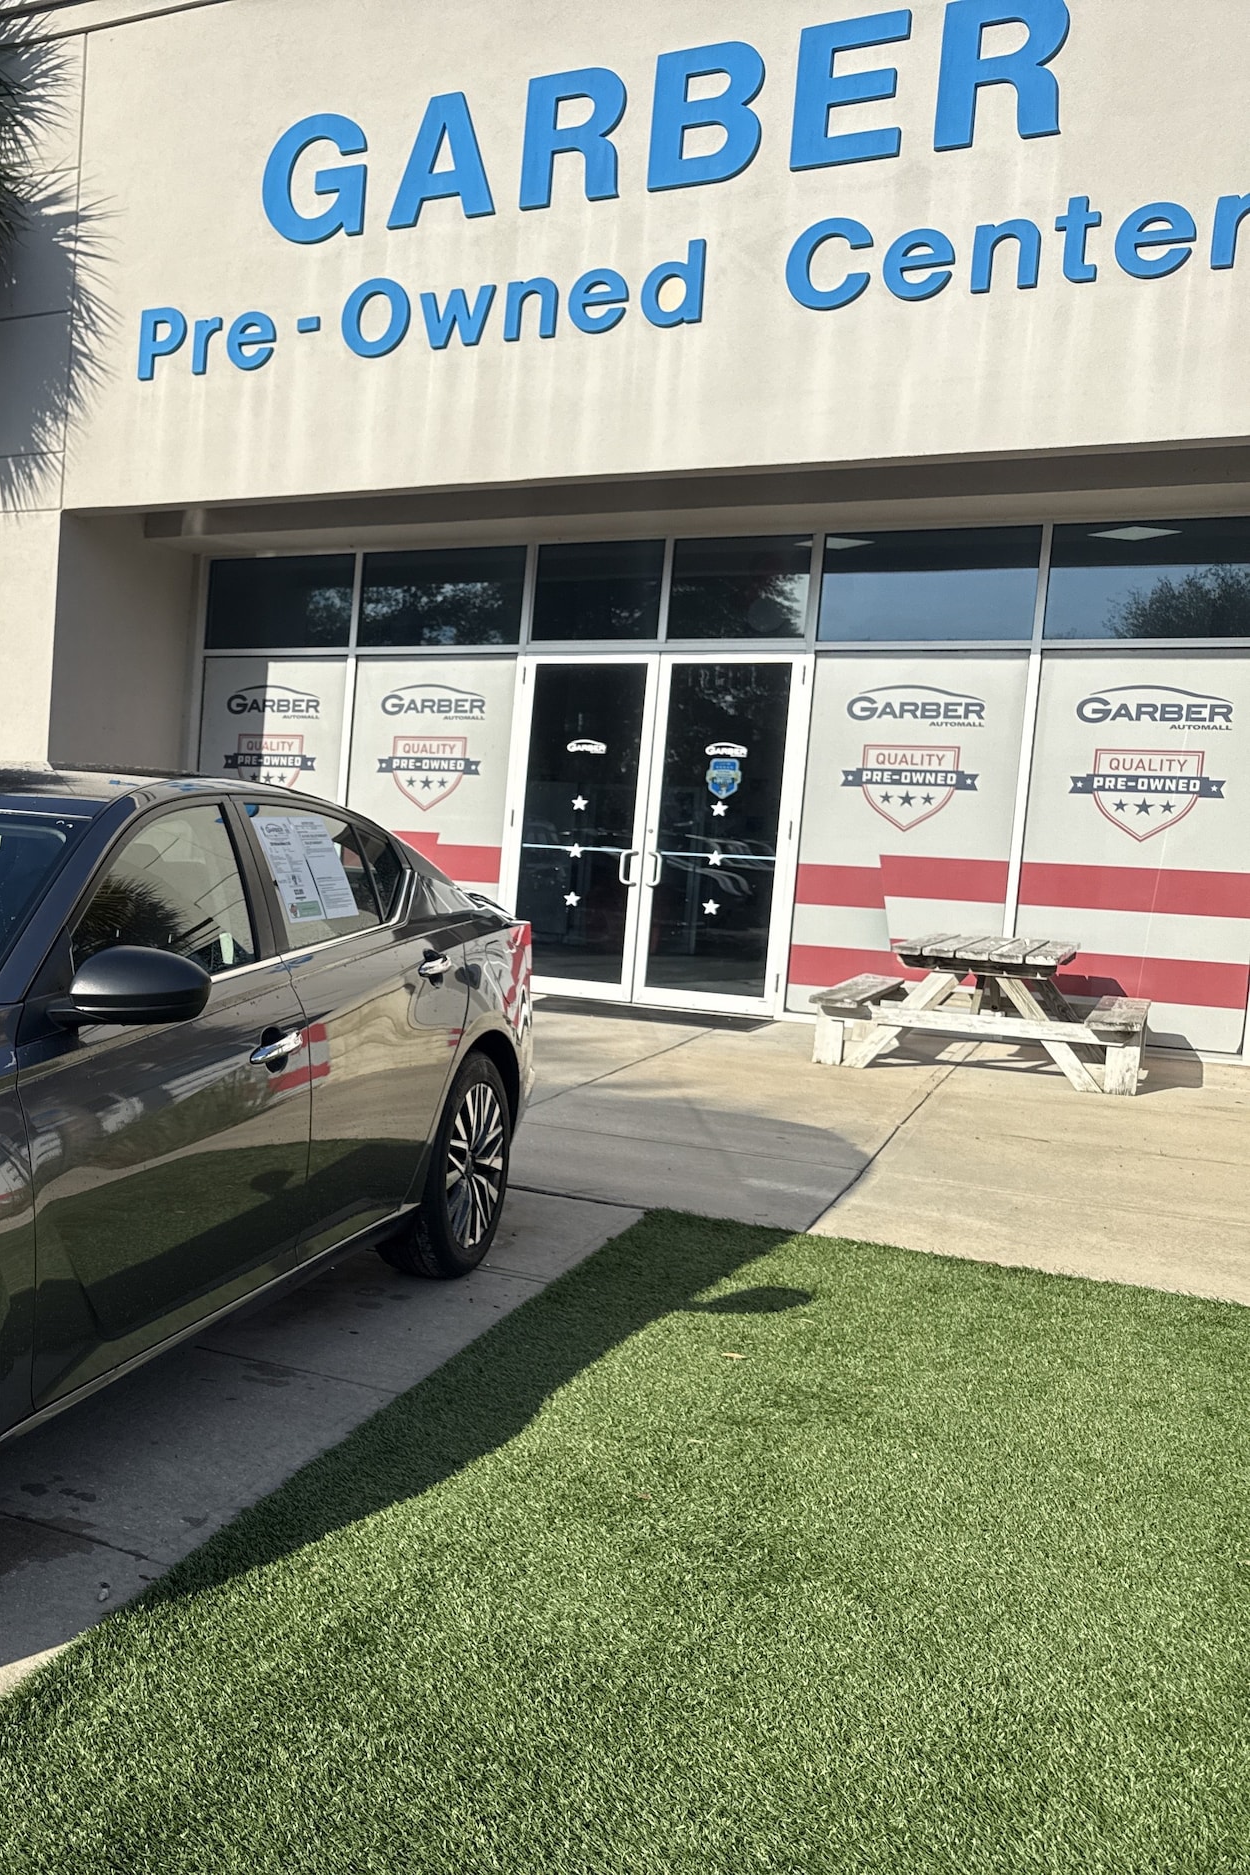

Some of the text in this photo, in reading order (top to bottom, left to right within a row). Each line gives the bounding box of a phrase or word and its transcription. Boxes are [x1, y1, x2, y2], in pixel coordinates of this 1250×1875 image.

[262, 0, 1070, 244] GARBER
[785, 192, 1250, 311] Center
[227, 694, 320, 715] GARBER
[381, 694, 485, 716] GARBER
[847, 696, 985, 721] GARBER
[1076, 696, 1234, 723] GARBER
[246, 740, 294, 751] QUALITY
[403, 743, 456, 754] QUALITY
[238, 755, 301, 766] PRE-OWNED
[392, 759, 464, 770] PRE-OWNED
[876, 752, 945, 766] QUALITY
[1109, 758, 1188, 772] QUALITY
[862, 771, 957, 785] PRE-OWNED
[1093, 777, 1200, 792] PRE-OWNED
